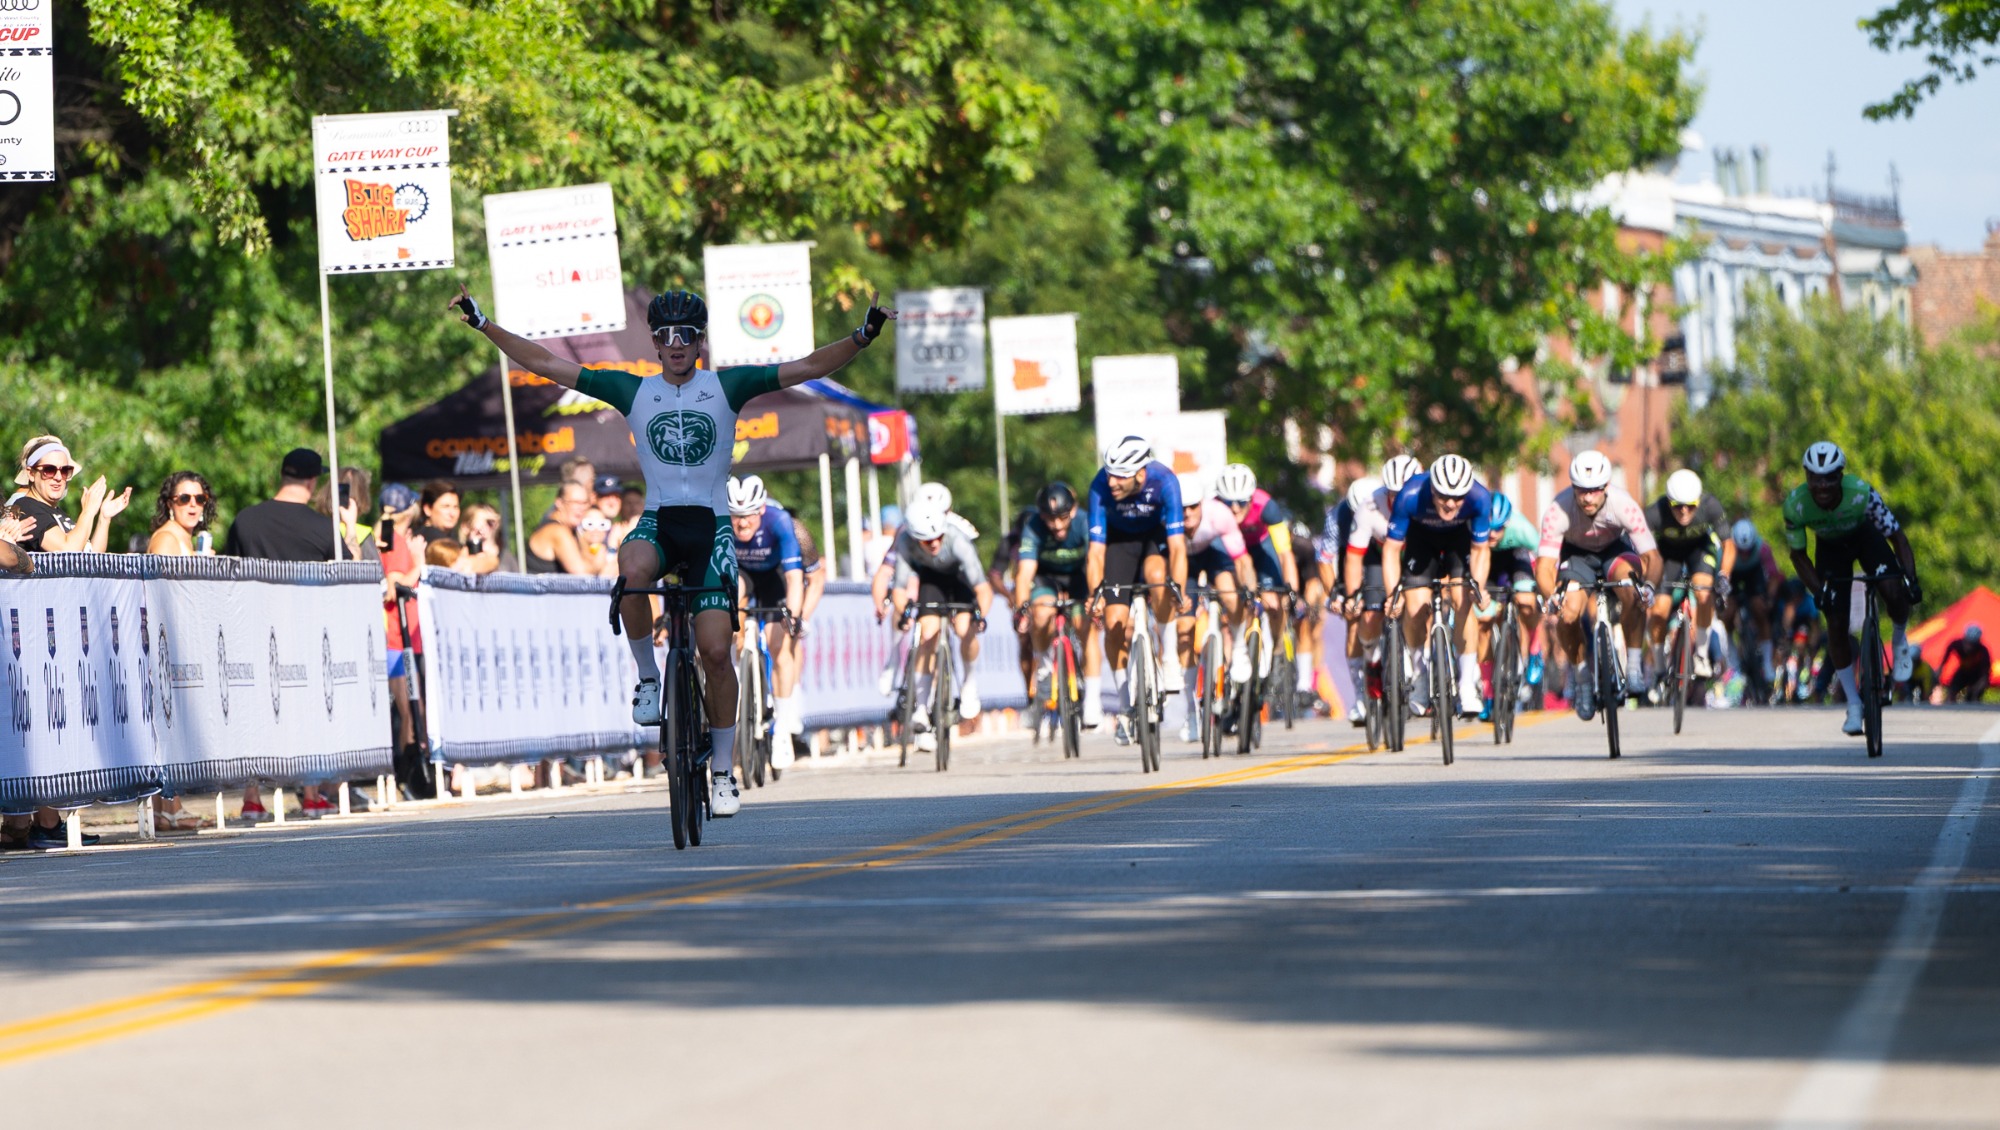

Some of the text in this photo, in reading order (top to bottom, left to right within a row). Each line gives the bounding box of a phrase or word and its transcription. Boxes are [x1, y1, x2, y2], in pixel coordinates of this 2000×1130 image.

[0, 27, 40, 41] CUP
[344, 178, 397, 208] BIG
[343, 206, 410, 241] SHARK
